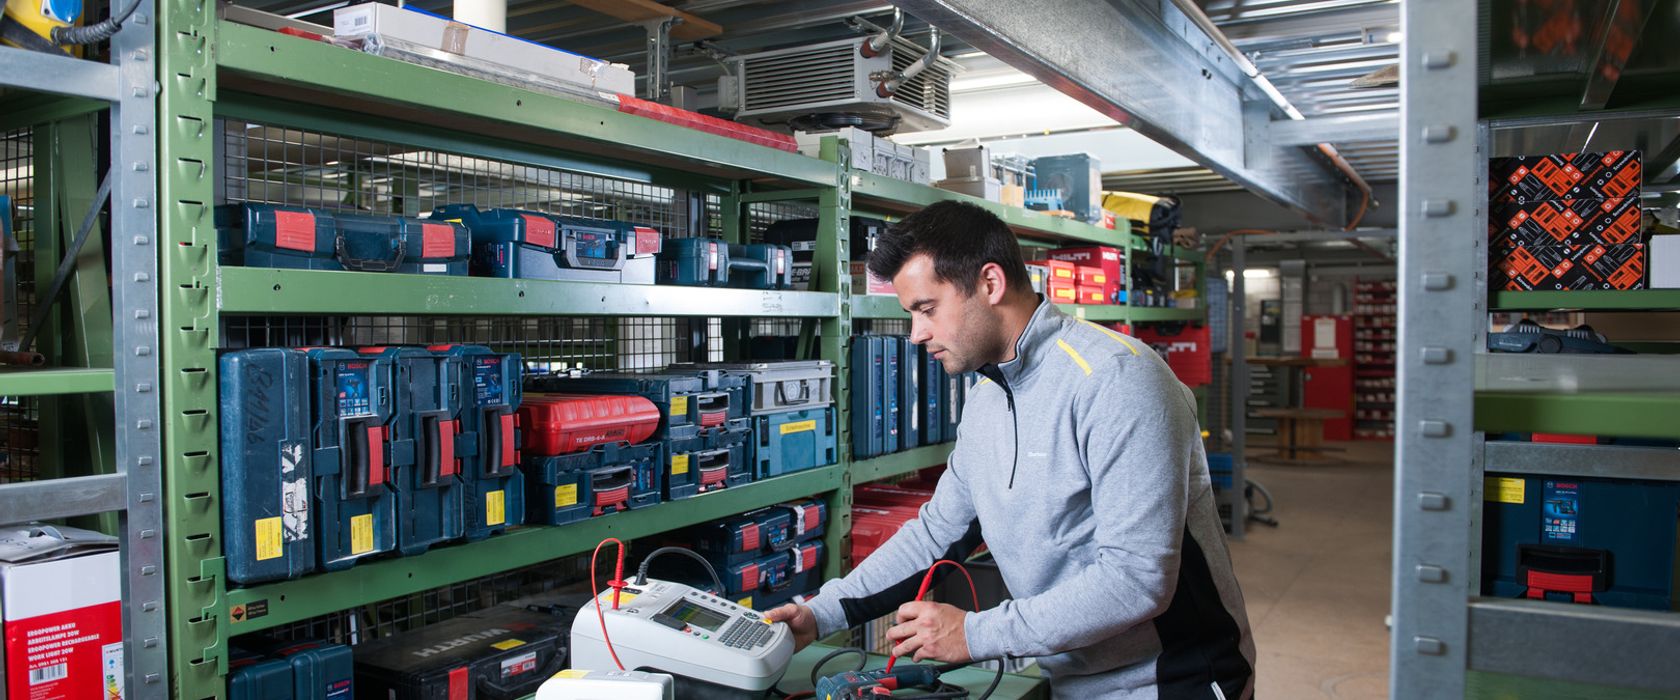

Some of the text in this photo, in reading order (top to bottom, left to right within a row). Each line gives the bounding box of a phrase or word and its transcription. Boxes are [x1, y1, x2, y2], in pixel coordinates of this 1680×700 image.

[27, 625, 60, 637] ERGOPOWER
[27, 632, 66, 646] ARBEITSLAMPE
[28, 642, 60, 653] ERGOPOWER
[28, 654, 45, 662] WORK
[45, 649, 60, 658] LIGHT
